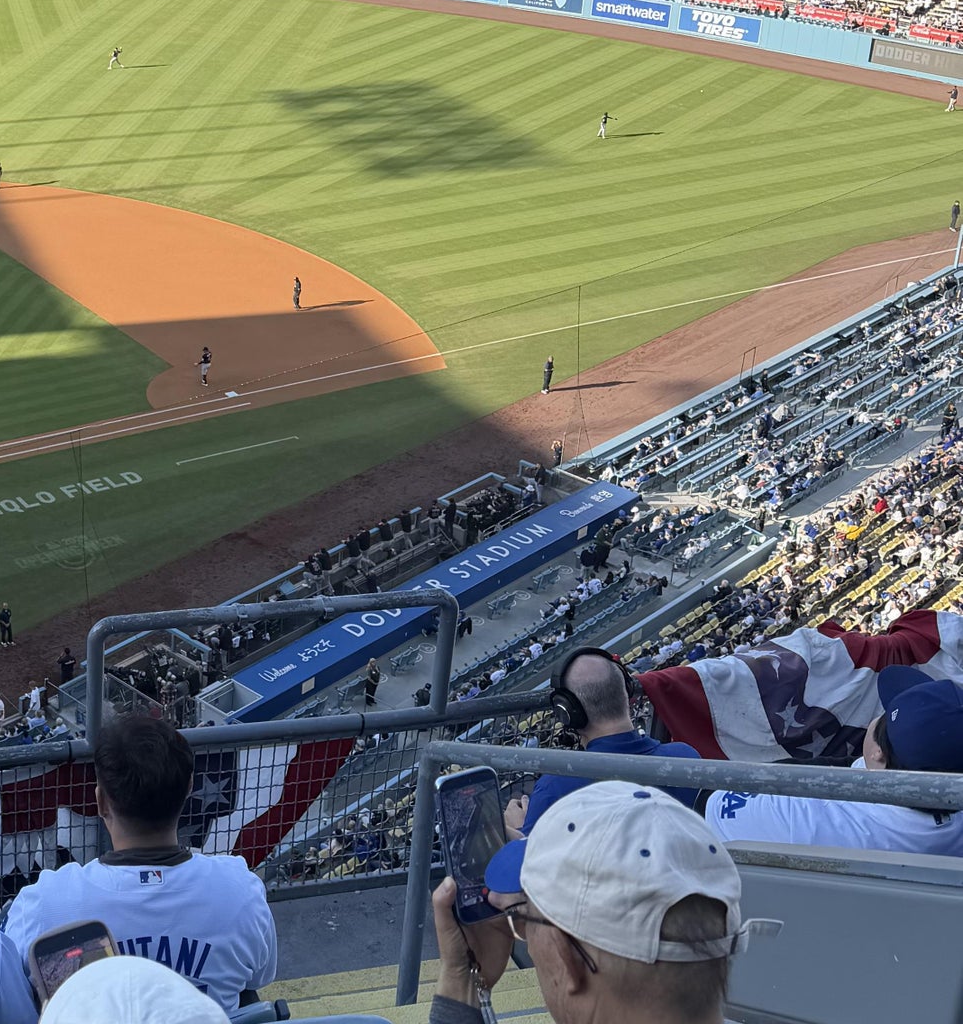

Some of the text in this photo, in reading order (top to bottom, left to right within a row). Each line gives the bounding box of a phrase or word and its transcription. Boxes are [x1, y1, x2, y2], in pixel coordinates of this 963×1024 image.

[596, 1, 666, 22] smartwater
[692, 10, 736, 26] TOYO
[697, 22, 745, 40] TIRES
[875, 44, 930, 65] DODGER
[59, 471, 144, 498] FIELD
[342, 524, 552, 638] DODR STADIUM
[298, 638, 336, 662] ようこそ
[258, 663, 297, 682] Welcome
